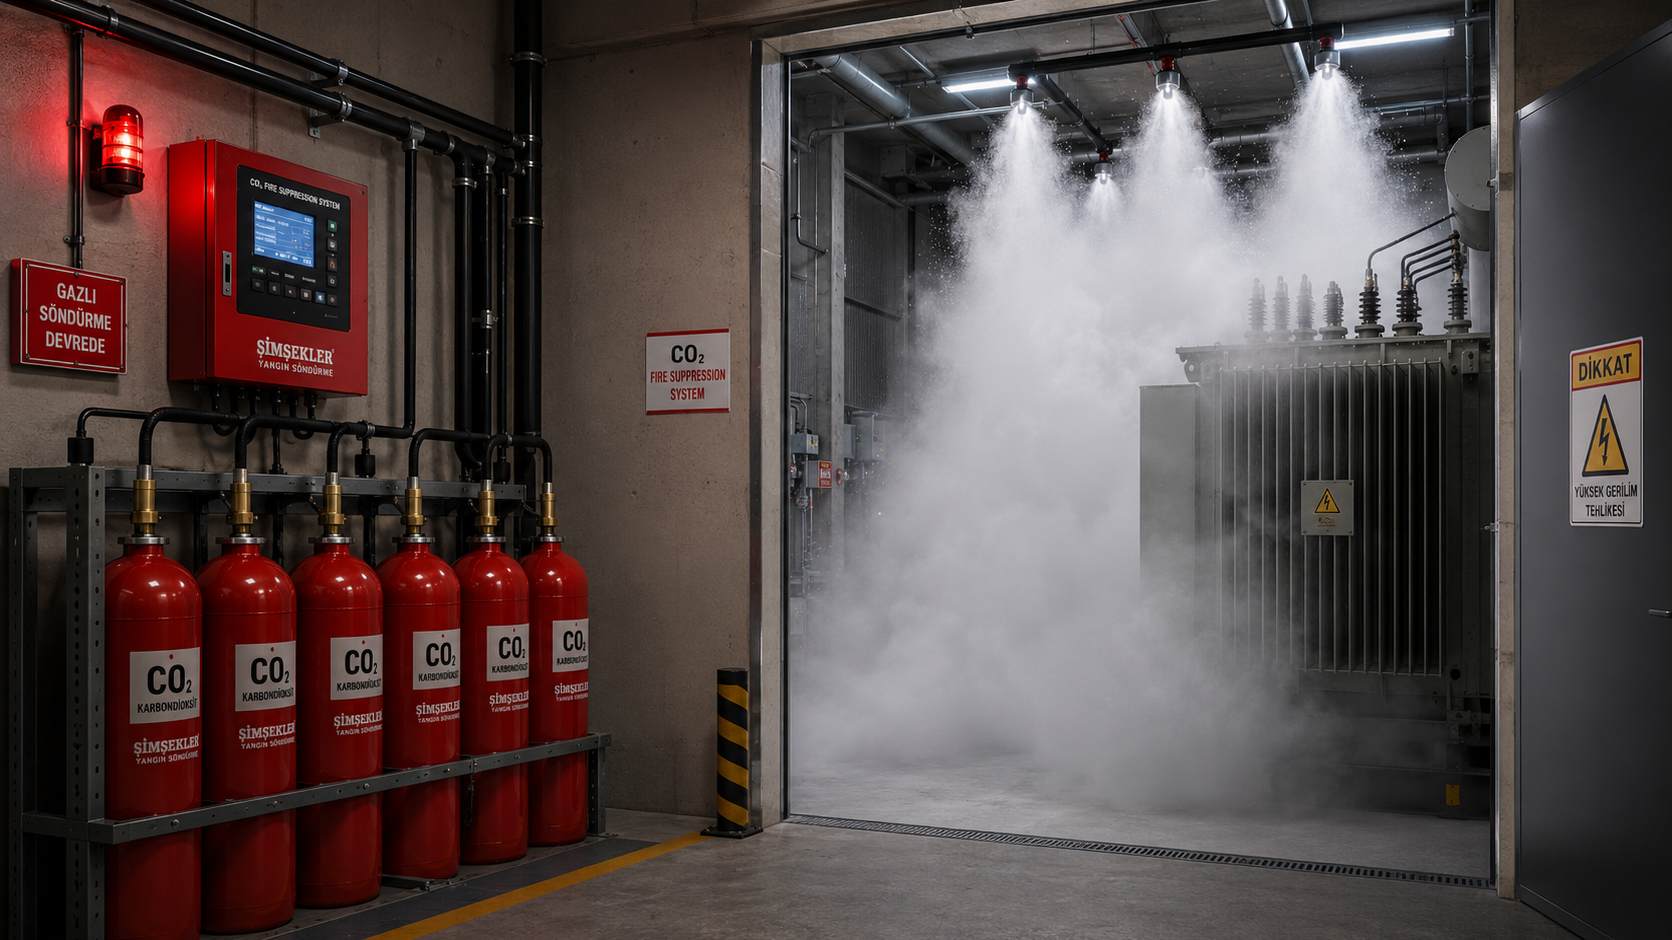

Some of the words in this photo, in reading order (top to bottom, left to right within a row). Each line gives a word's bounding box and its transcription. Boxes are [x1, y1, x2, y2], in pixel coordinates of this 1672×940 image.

[264, 182, 277, 193] FIRE
[319, 198, 340, 211] SYSTEM
[56, 282, 97, 304] GAZLI
[39, 303, 112, 331] SÖNDÜRME
[45, 330, 106, 354] DEVREDE
[258, 359, 290, 371] YANGIN
[291, 362, 334, 377] SÖNDÜRME
[650, 370, 668, 383] FIRE
[669, 369, 726, 383] SUPPRESSION
[1578, 353, 1632, 381] DİKKAT
[670, 387, 705, 400] SYSTEM
[1574, 483, 1604, 498] YÜKSEK
[1605, 481, 1638, 498] GERİLİM
[1585, 501, 1625, 517] TEHLİKESİ
[135, 755, 166, 765] YANGIN
